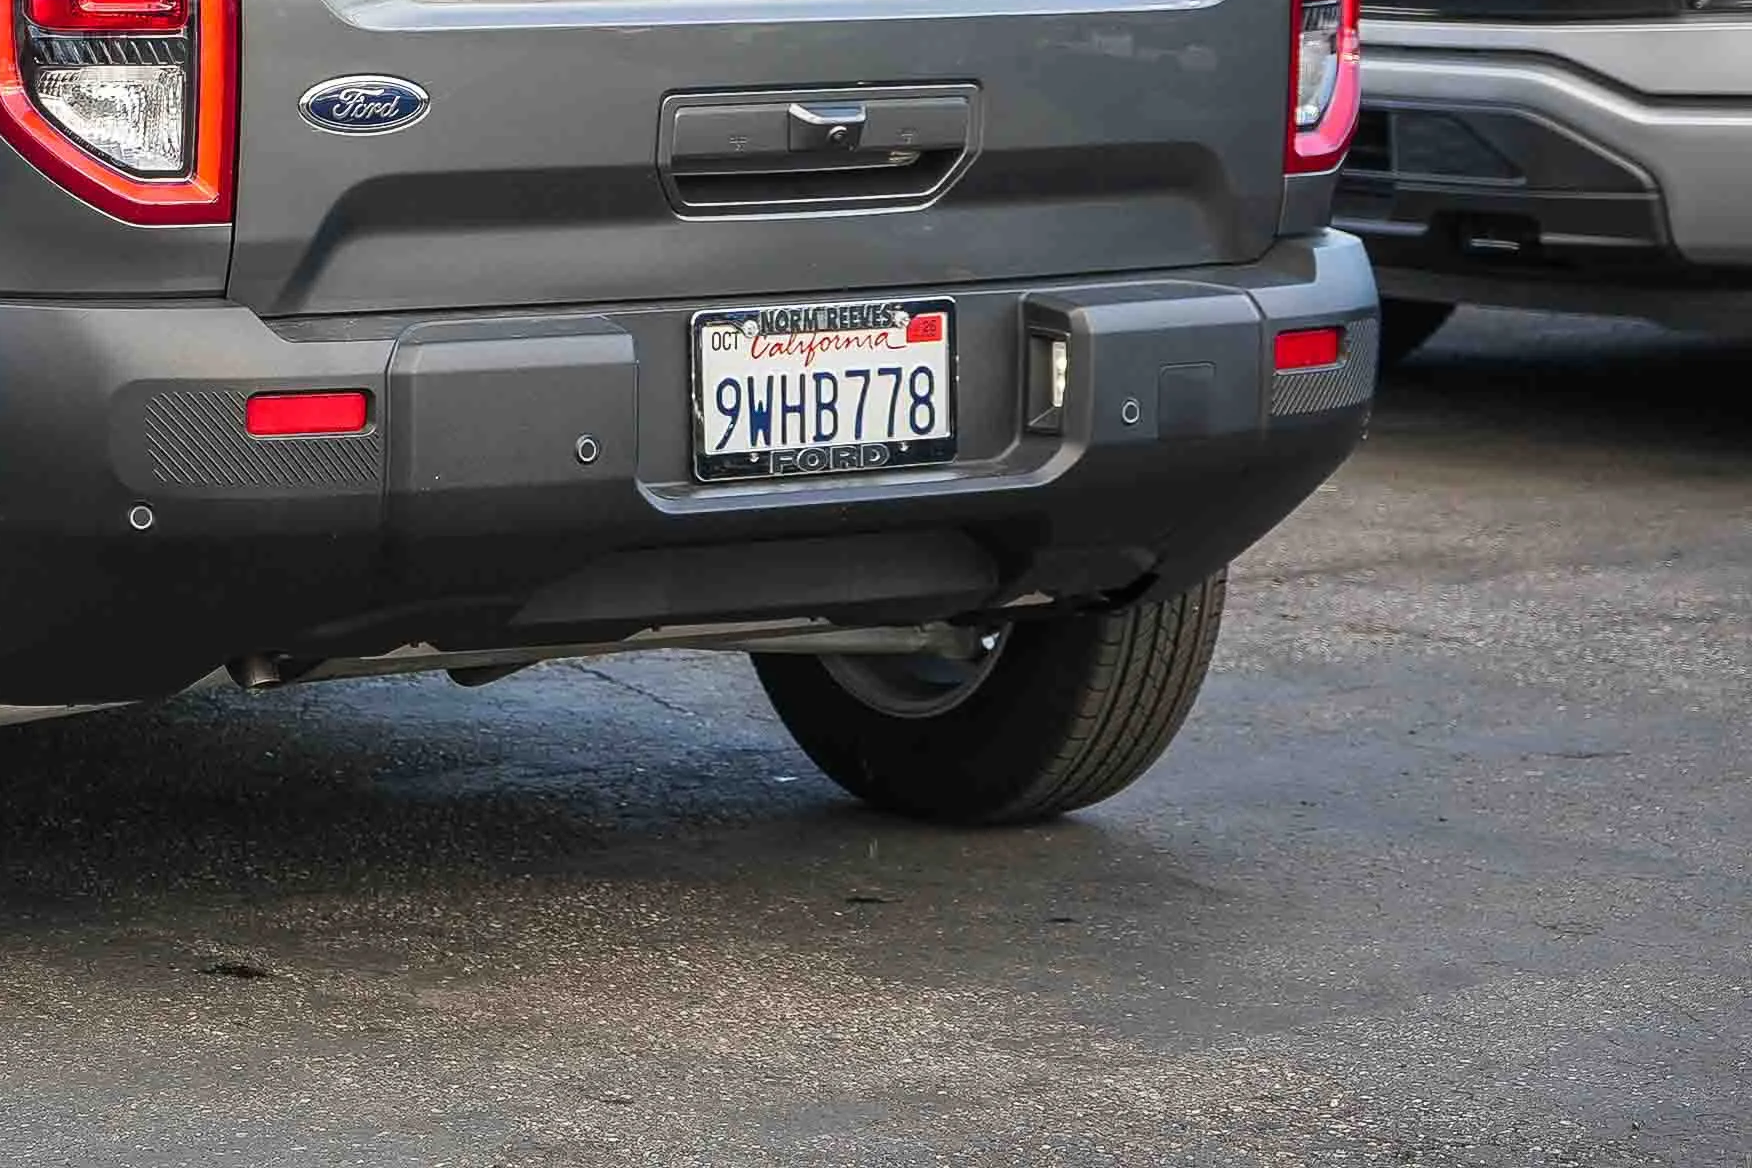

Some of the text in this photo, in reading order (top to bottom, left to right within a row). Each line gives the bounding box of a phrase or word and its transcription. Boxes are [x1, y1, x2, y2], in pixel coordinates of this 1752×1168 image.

[759, 302, 893, 333] NORM REEVES
[711, 330, 742, 351] OCT
[750, 330, 907, 368] California
[715, 365, 935, 450] 9WHB778
[768, 442, 890, 476] FORD
